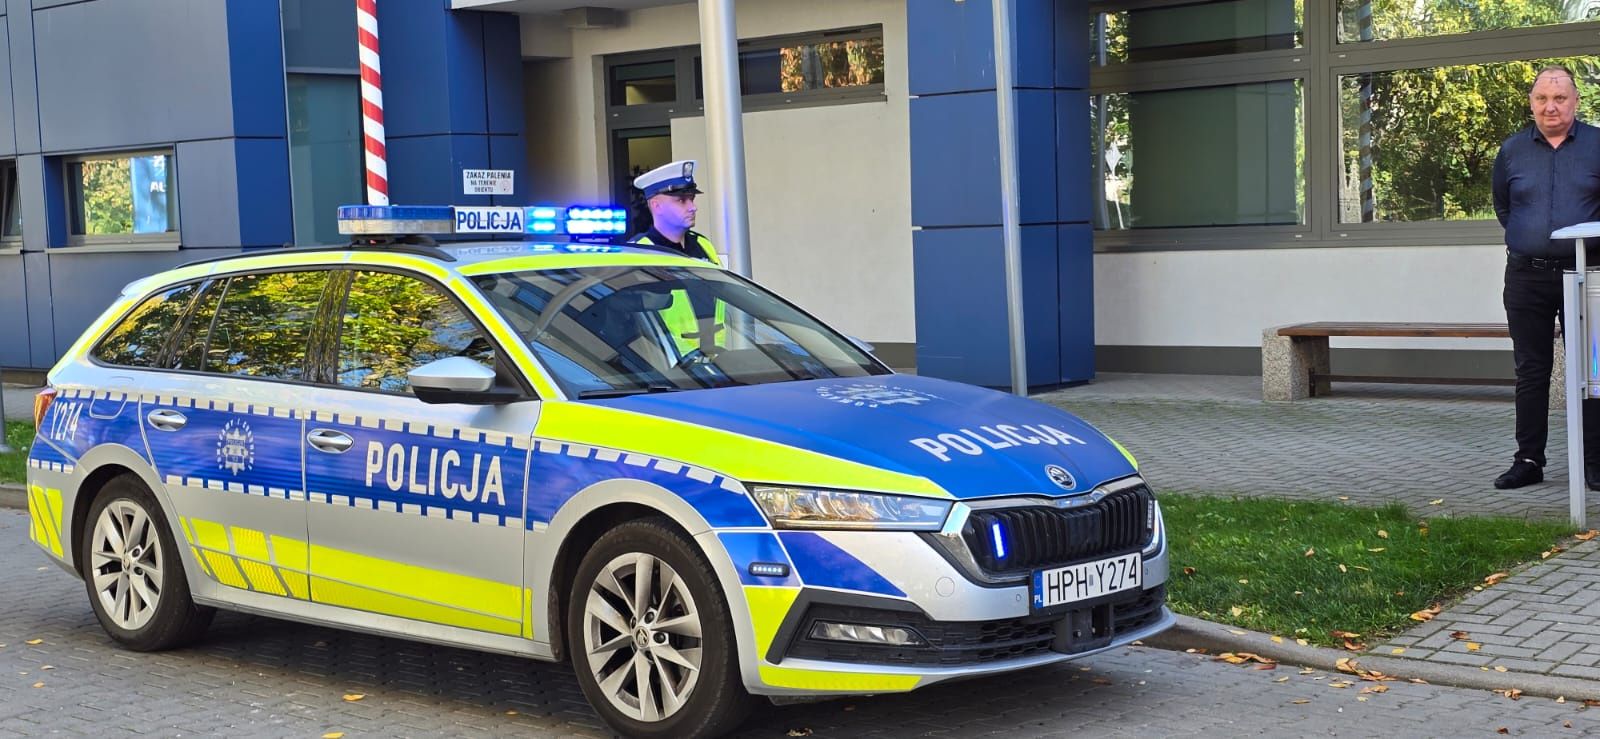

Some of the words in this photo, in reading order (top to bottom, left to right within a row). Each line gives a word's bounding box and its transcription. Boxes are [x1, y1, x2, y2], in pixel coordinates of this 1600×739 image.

[466, 171, 485, 179] ZAKAZ
[486, 171, 511, 179] PALENIA
[456, 211, 522, 230] POLICJA
[50, 401, 83, 440] Y274
[909, 424, 1087, 462] POLICJA
[365, 441, 506, 506] POLICJA
[1034, 594, 1042, 604] PL
[1047, 566, 1089, 604] HPH
[1095, 556, 1137, 593] Y274
